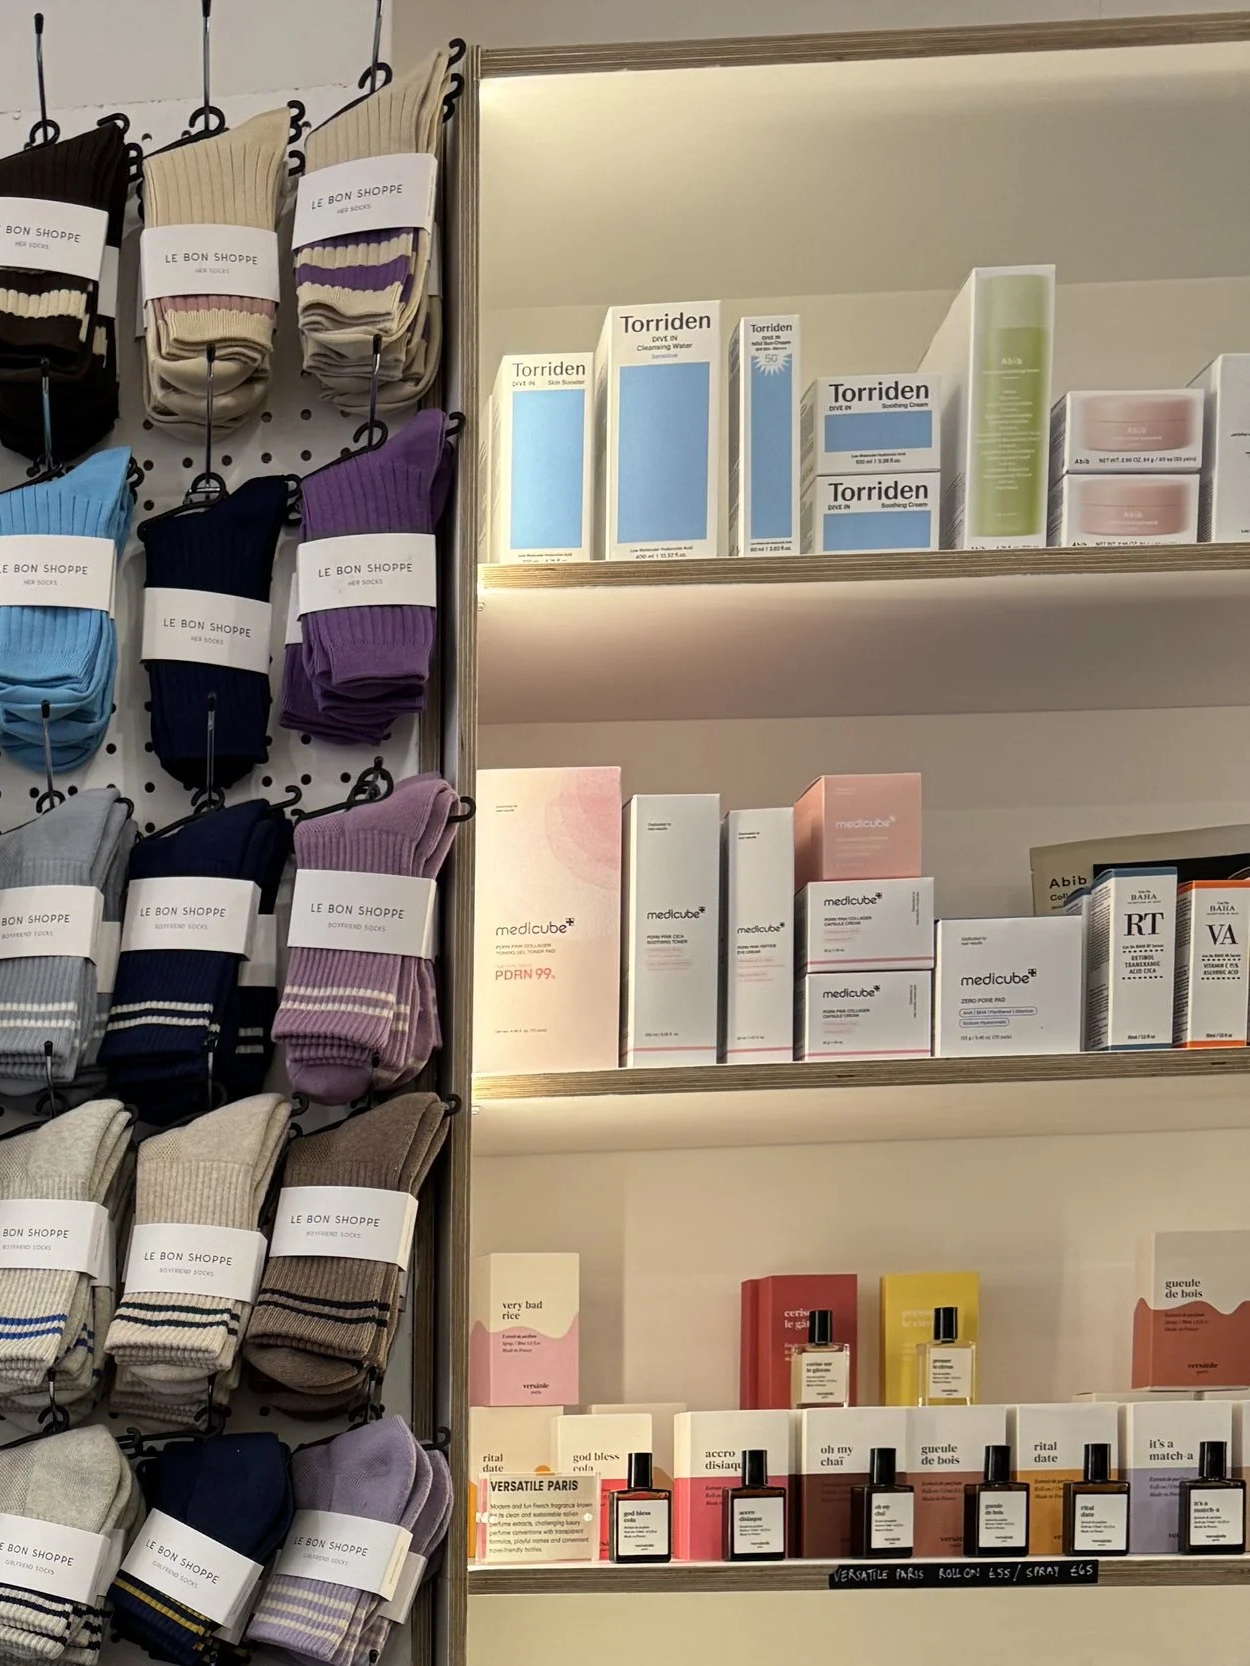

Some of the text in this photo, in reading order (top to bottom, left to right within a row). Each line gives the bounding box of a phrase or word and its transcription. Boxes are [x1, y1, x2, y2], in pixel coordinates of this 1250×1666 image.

[6, 226, 30, 235] BON
[36, 228, 81, 242] SHOPPE
[620, 312, 711, 333] Torriden
[750, 323, 793, 333] Torriden
[636, 342, 692, 352] Cleansing Water
[1001, 357, 1022, 366] Abib
[512, 361, 586, 377] Torriden
[829, 381, 929, 402] Torriden
[828, 481, 928, 501] Torriden
[319, 563, 412, 577] LE BON SHOPPE
[1050, 876, 1086, 889] Abib
[824, 896, 877, 906] medicube
[647, 909, 700, 920] medicube
[496, 921, 567, 936] medicube
[737, 924, 780, 934] medicube
[1124, 912, 1164, 936] RT
[1206, 924, 1239, 945] VA
[495, 969, 532, 981] PDRN
[960, 970, 1029, 986] medicube
[822, 987, 874, 999] medicube
[291, 1215, 380, 1227] LE BON SHOPPE
[1165, 1279, 1200, 1289] gueule
[1165, 1289, 1203, 1298] de bois
[502, 1301, 542, 1311] very bad
[821, 1445, 853, 1456] oh my
[921, 1443, 958, 1455] gueule
[1034, 1441, 1057, 1451] rital
[1167, 1441, 1174, 1449] a
[482, 1453, 503, 1462] rital
[573, 1452, 620, 1463] god bless
[705, 1450, 735, 1458] accro
[921, 1454, 960, 1465] de bois
[1034, 1452, 1058, 1463] date
[1149, 1451, 1193, 1461] match-a
[482, 1464, 504, 1472] date
[573, 1464, 593, 1472] cola
[491, 1481, 578, 1491] VERSATILE PARIS
[833, 1569, 888, 1582] VERSATILE
[896, 1569, 924, 1580] PARIS
[1026, 1566, 1059, 1578] SPRAY
[1070, 1565, 1093, 1576] £65
